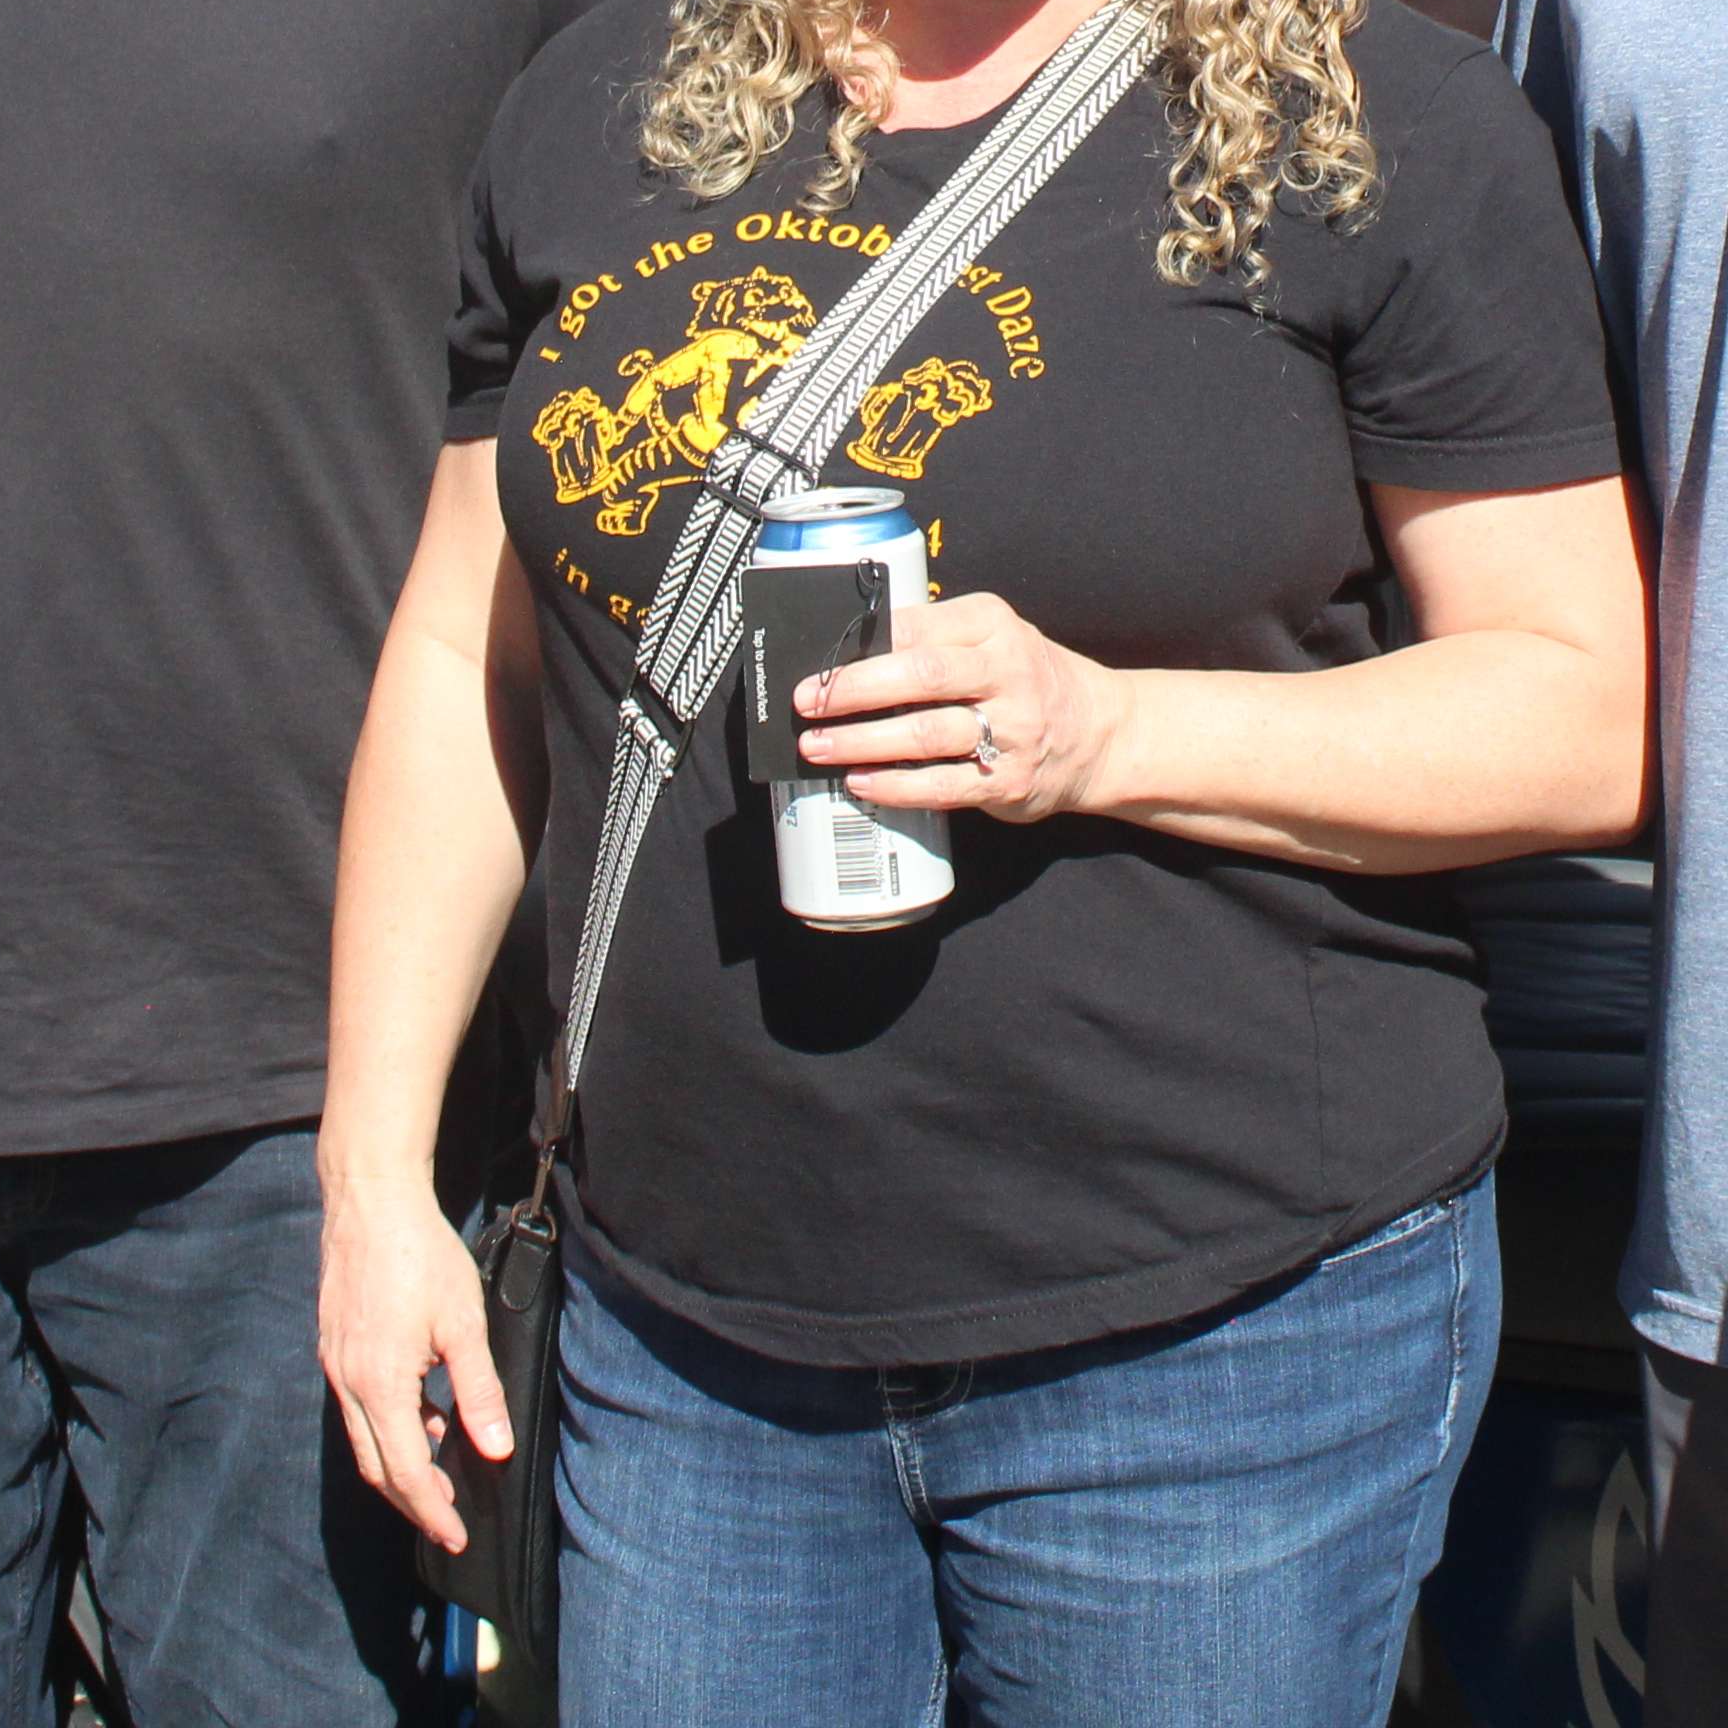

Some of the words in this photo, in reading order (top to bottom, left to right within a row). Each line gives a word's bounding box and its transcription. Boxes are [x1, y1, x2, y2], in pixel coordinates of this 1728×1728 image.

[633, 230, 716, 279] the
[984, 285, 1047, 380] Daze
[752, 627, 765, 648] Tap
[754, 649, 765, 661] to
[755, 662, 770, 724] unlock/lock
